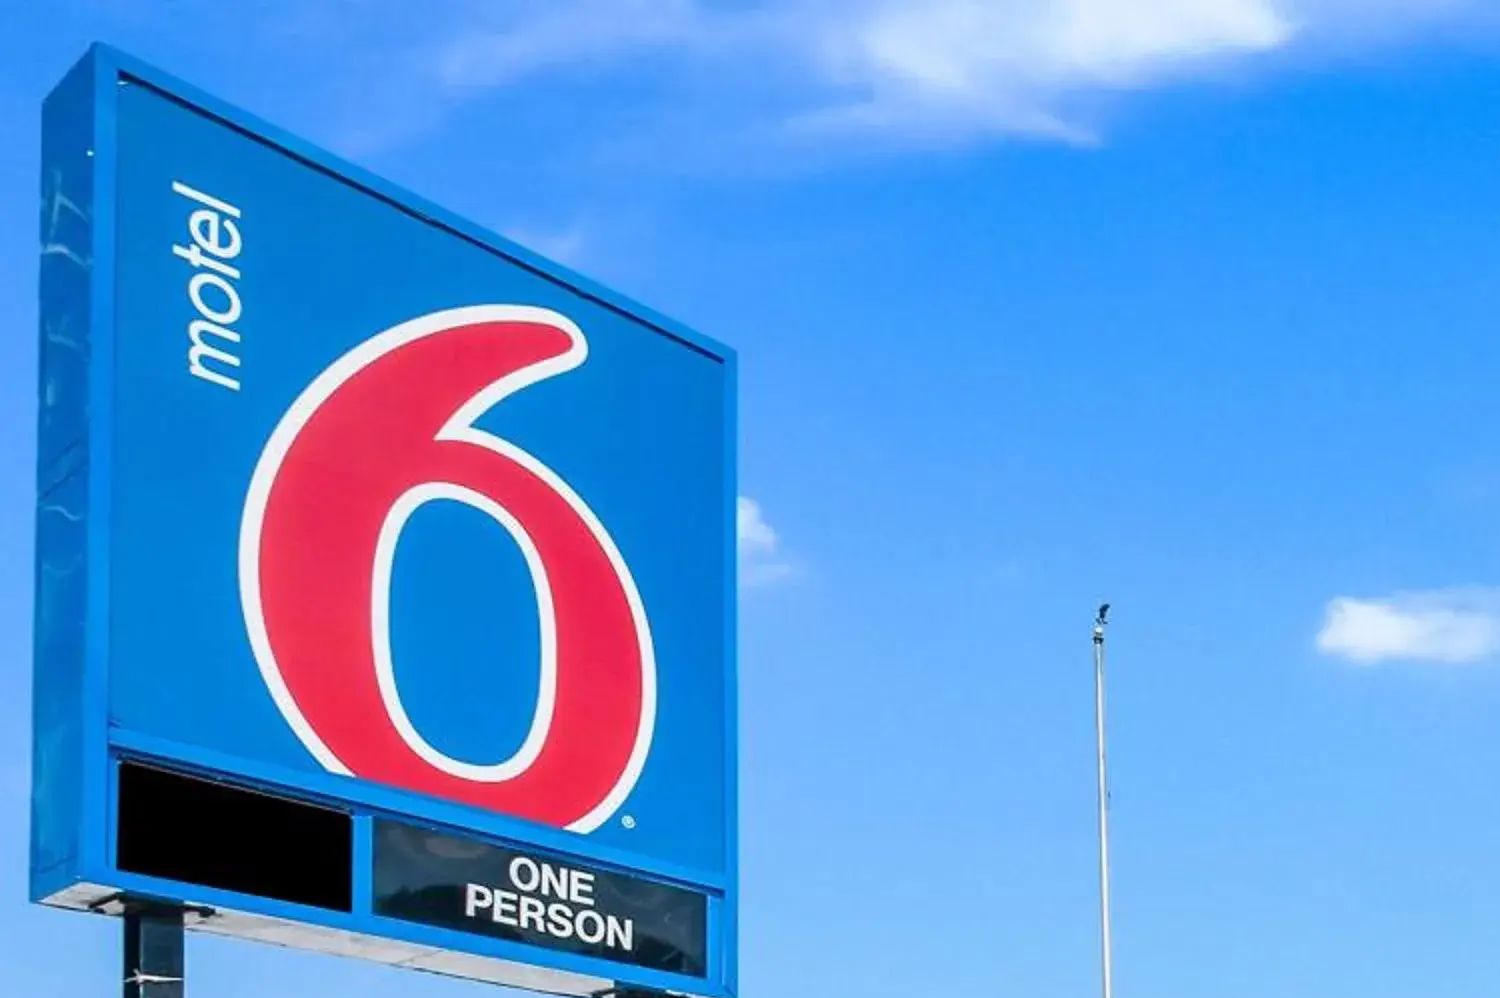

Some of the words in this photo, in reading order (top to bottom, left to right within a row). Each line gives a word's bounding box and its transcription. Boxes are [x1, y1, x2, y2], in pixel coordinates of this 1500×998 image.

[171, 180, 242, 391] motel
[238, 303, 657, 834] 6
[466, 884, 633, 950] PERSON
[509, 857, 595, 905] ONE
